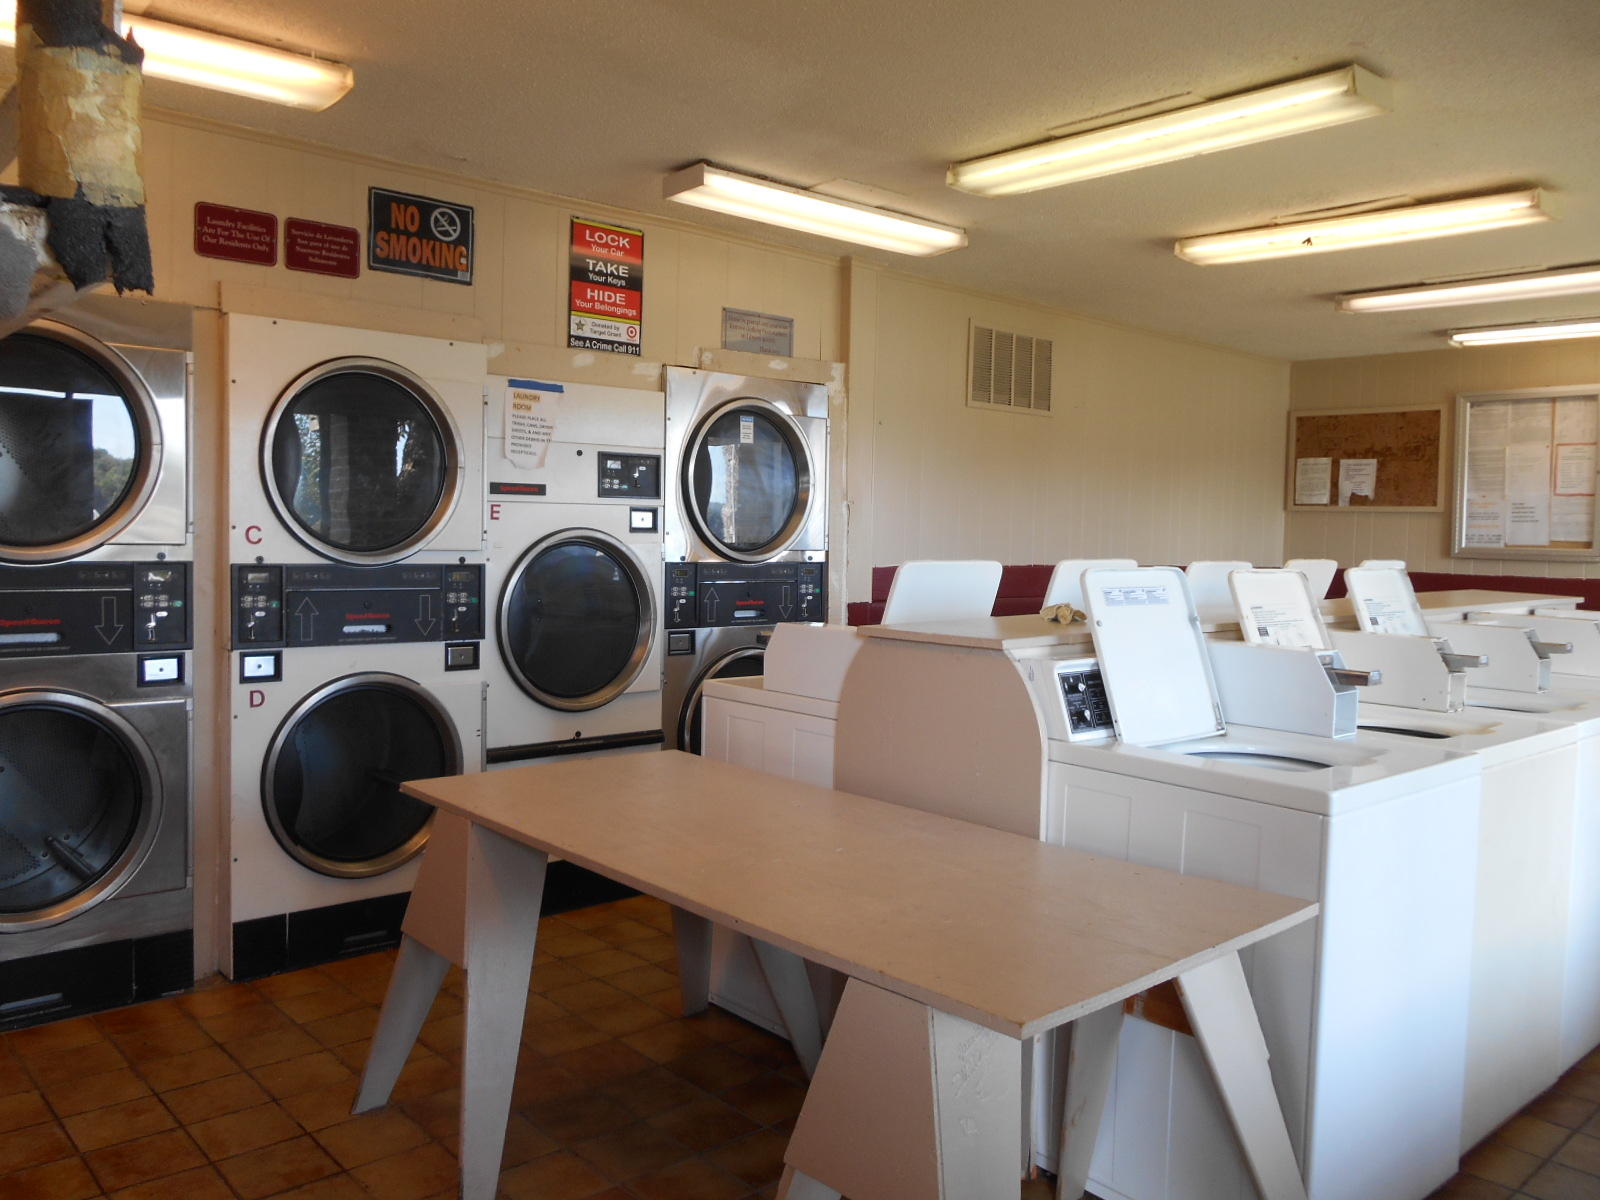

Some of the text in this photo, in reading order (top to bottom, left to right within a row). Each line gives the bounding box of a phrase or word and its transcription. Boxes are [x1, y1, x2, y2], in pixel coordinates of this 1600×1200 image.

[390, 202, 420, 232] NO
[585, 229, 630, 249] LOCK
[375, 231, 468, 272] SMOKING
[591, 243, 625, 257] Your Car
[585, 258, 629, 278] TAKE
[587, 272, 626, 287] Your Keys
[587, 287, 626, 306] HIDE
[575, 298, 637, 317] Your Belongings
[570, 337, 640, 355] See A Crime Call 911
[490, 504, 501, 521] E
[245, 525, 263, 545] C
[249, 690, 266, 708] D
